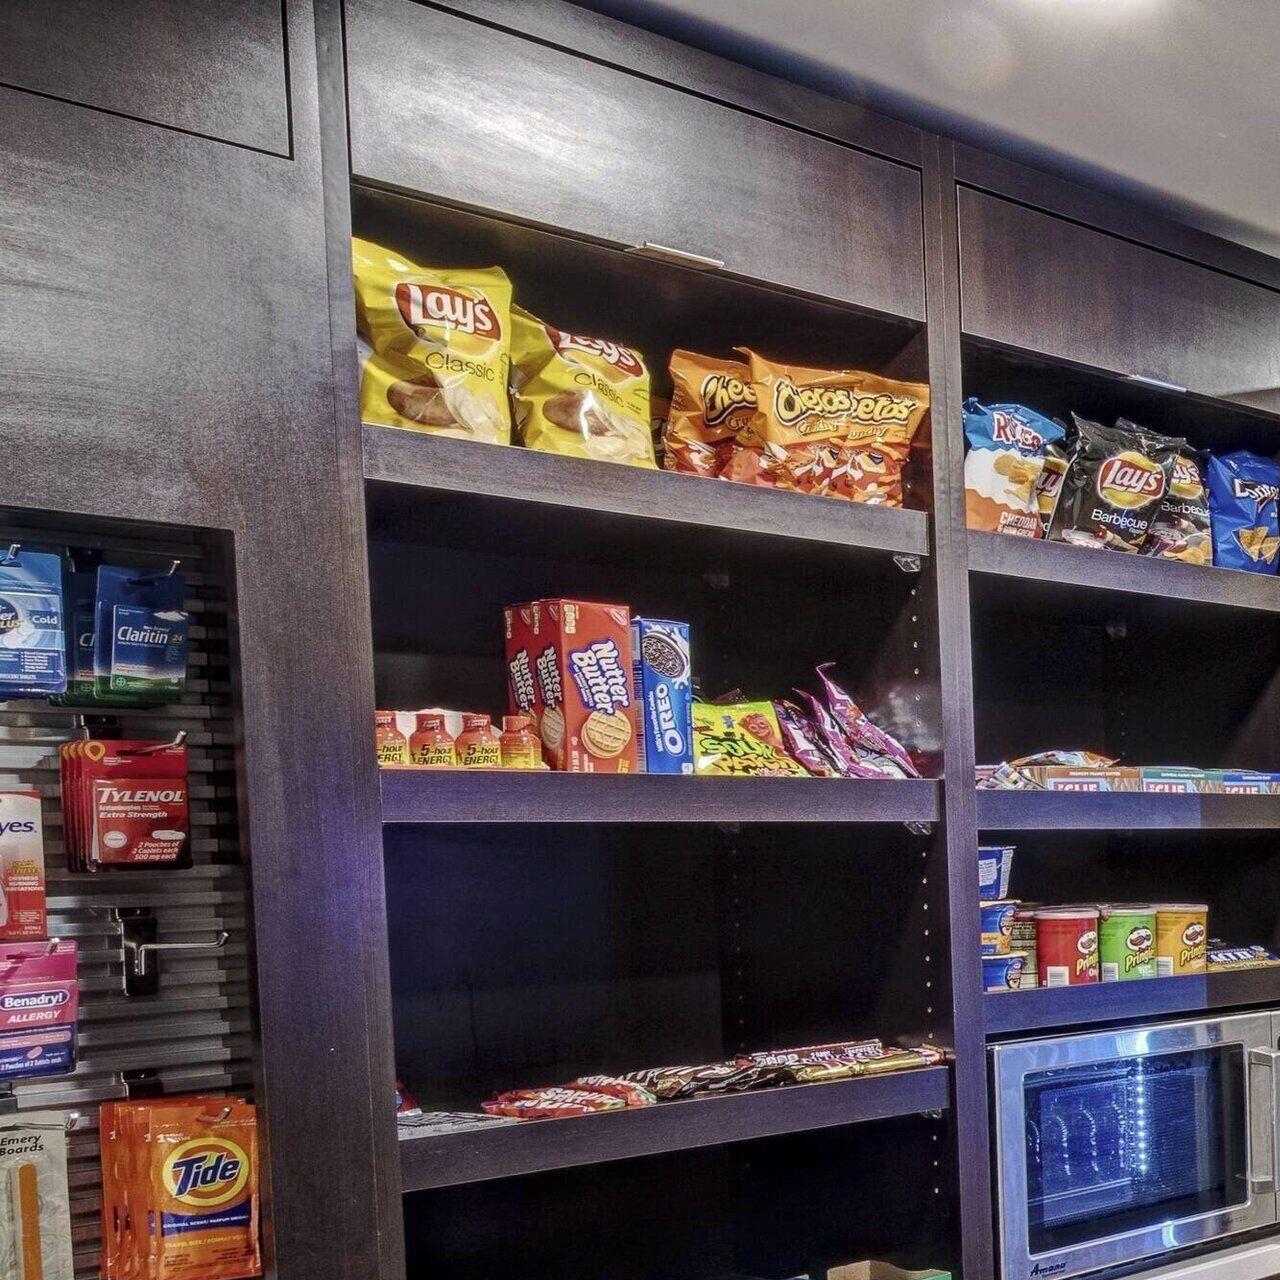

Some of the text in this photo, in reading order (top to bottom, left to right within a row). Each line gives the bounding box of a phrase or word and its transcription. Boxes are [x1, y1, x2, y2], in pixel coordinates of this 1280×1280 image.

[407, 284, 494, 334] Lay's
[426, 352, 495, 381] Classic
[574, 372, 625, 408] Classic
[704, 375, 757, 424] Chee
[852, 394, 915, 422] etos
[1104, 460, 1163, 493] Lay's
[1091, 508, 1148, 531] Barbecue
[0, 620, 20, 629] LUS
[32, 614, 58, 625] Cold
[118, 626, 168, 645] Claritin
[509, 660, 530, 712] Butter
[516, 649, 536, 704] Nutter
[536, 656, 556, 710] Butter
[543, 646, 563, 702] Nutter
[571, 649, 615, 715] Butter
[590, 640, 629, 707] Nutter
[655, 682, 687, 757] OREO
[700, 735, 776, 758] SOUR
[97, 787, 184, 804] TYLENOL
[100, 811, 168, 820] Extra Strength
[4, 992, 63, 1009] Benadryl
[8, 1010, 62, 1024] ALLERGY
[0, 1142, 45, 1157] Boards
[1, 1134, 42, 1148] Emery
[172, 1151, 242, 1199] Tide
[1030, 1260, 1068, 1278] Amana
